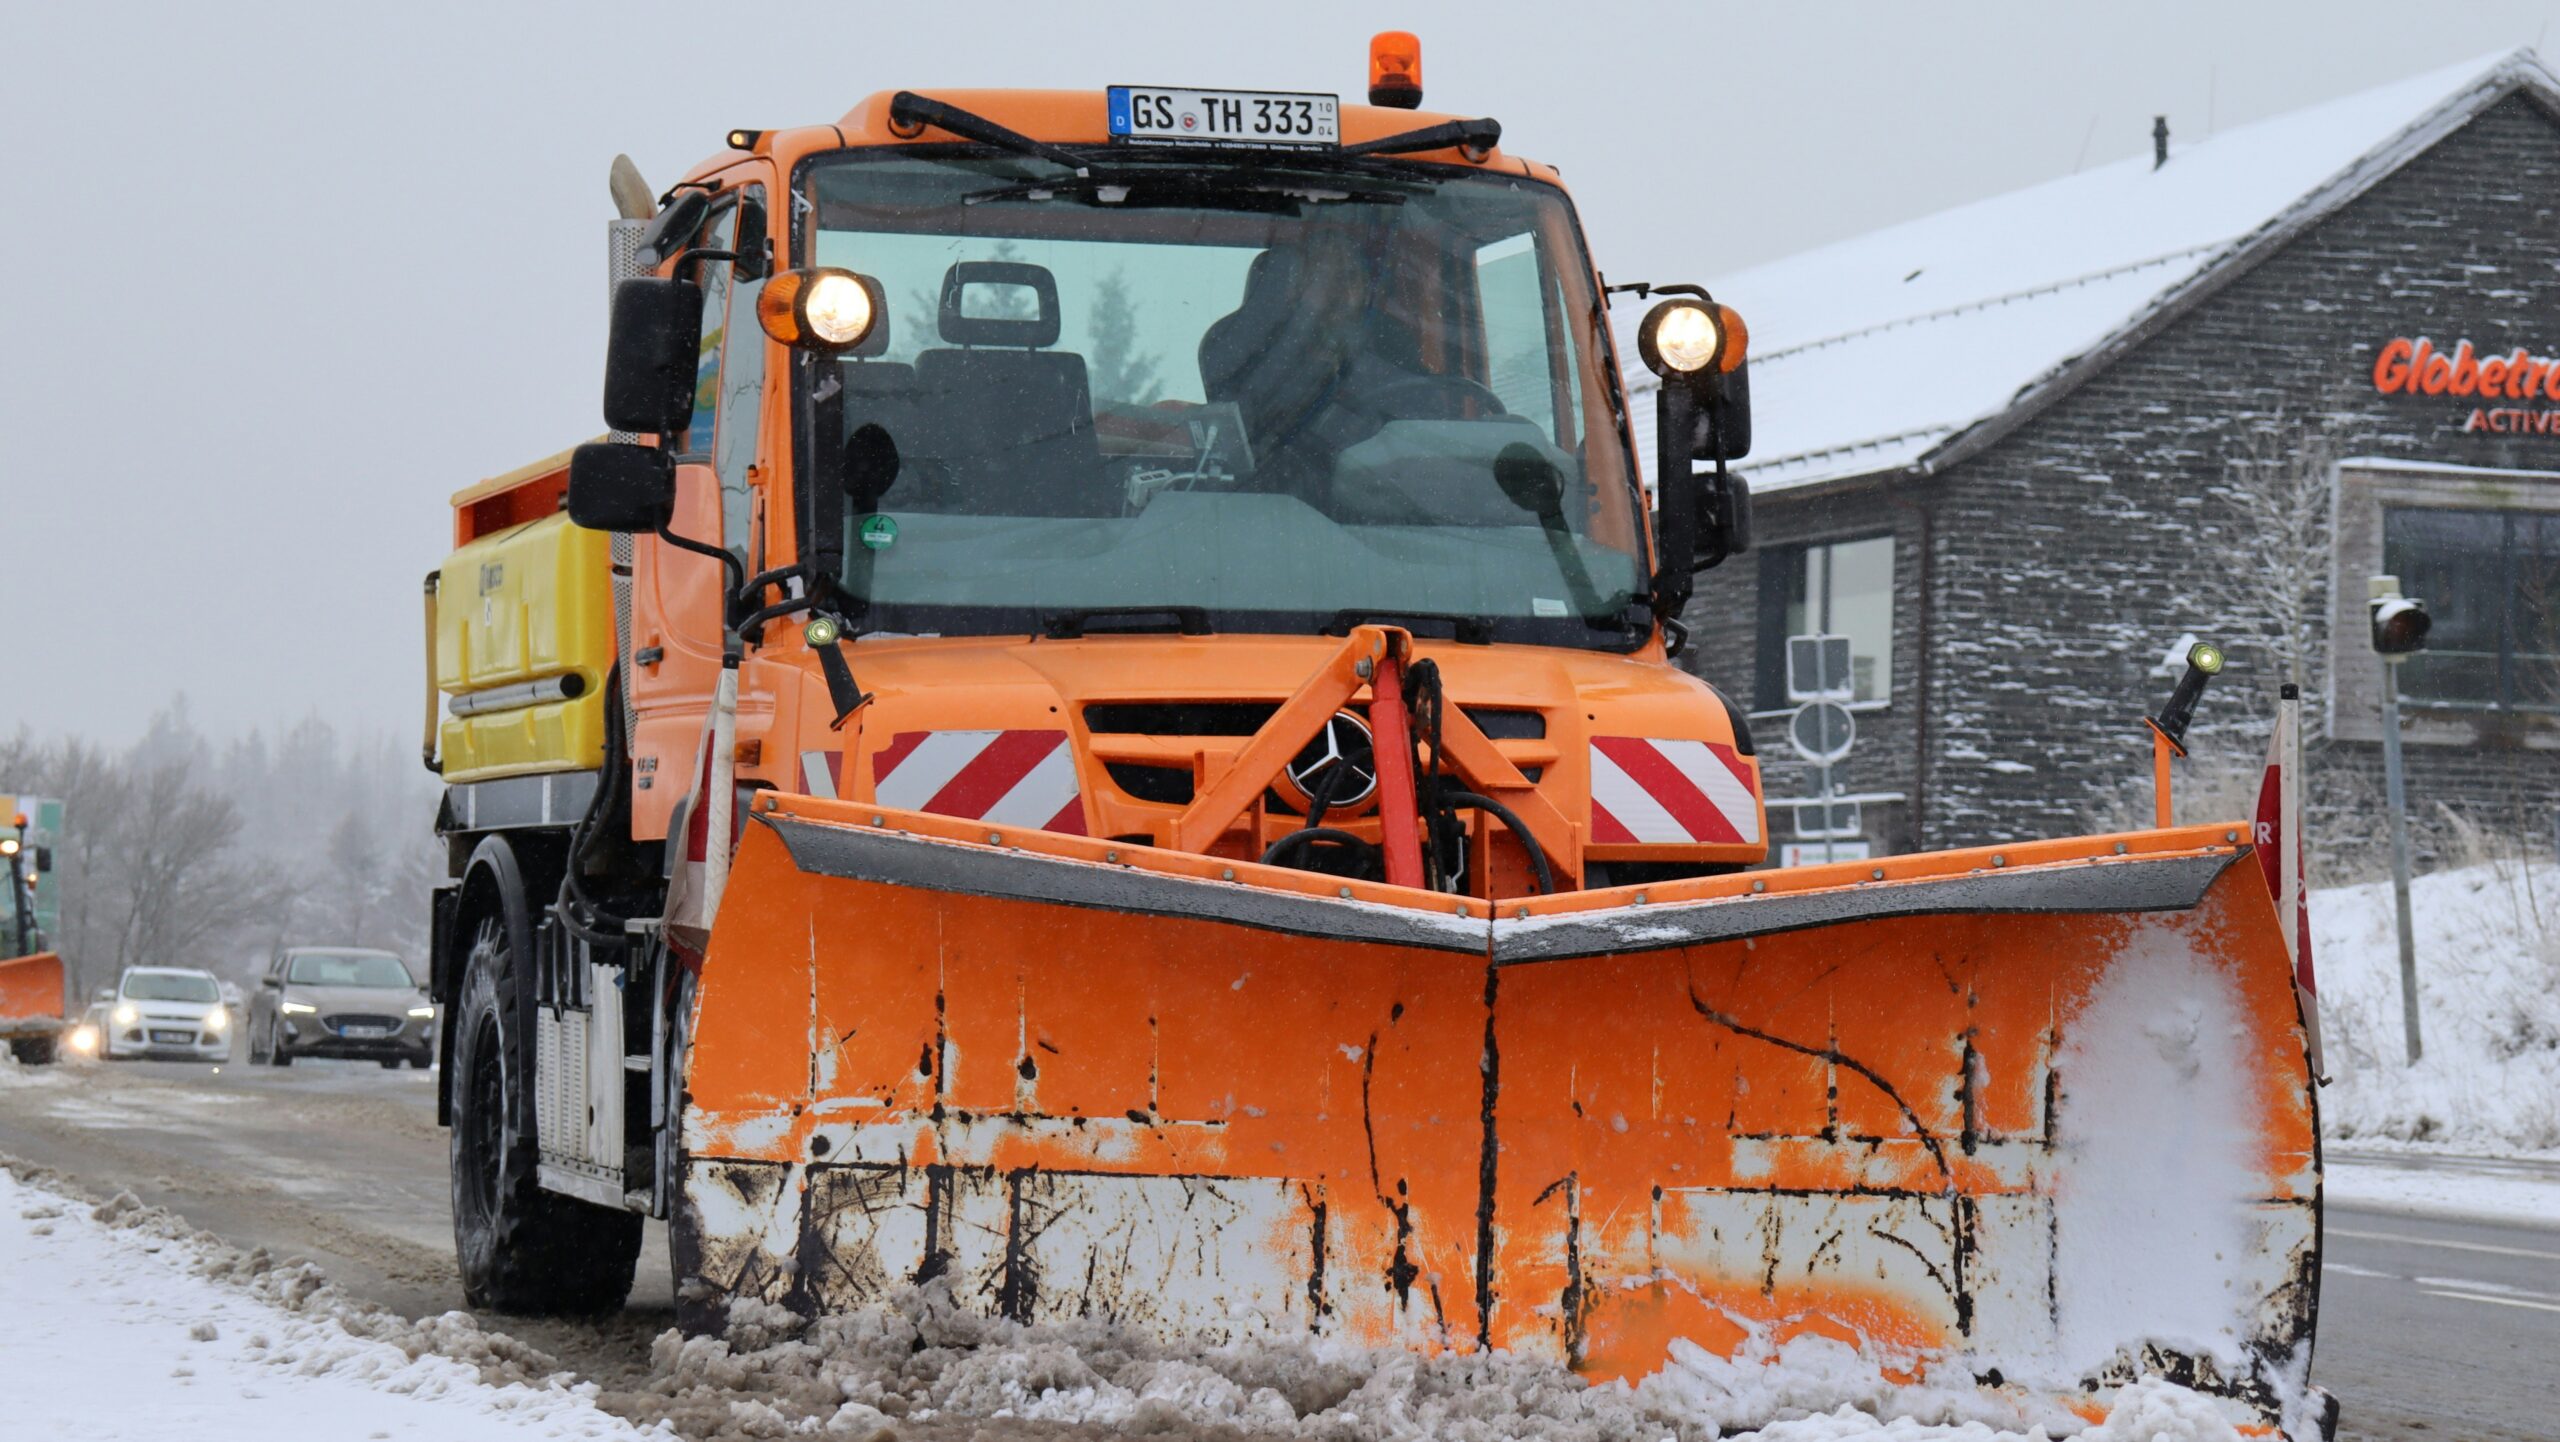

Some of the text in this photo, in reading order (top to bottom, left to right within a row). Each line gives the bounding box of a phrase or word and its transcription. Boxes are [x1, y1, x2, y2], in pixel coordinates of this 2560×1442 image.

[1318, 102, 1332, 113] 10
[1116, 115, 1125, 127] D
[1132, 95, 1313, 135] GS TH 333
[1318, 126, 1333, 136] 04
[873, 517, 885, 532] 4
